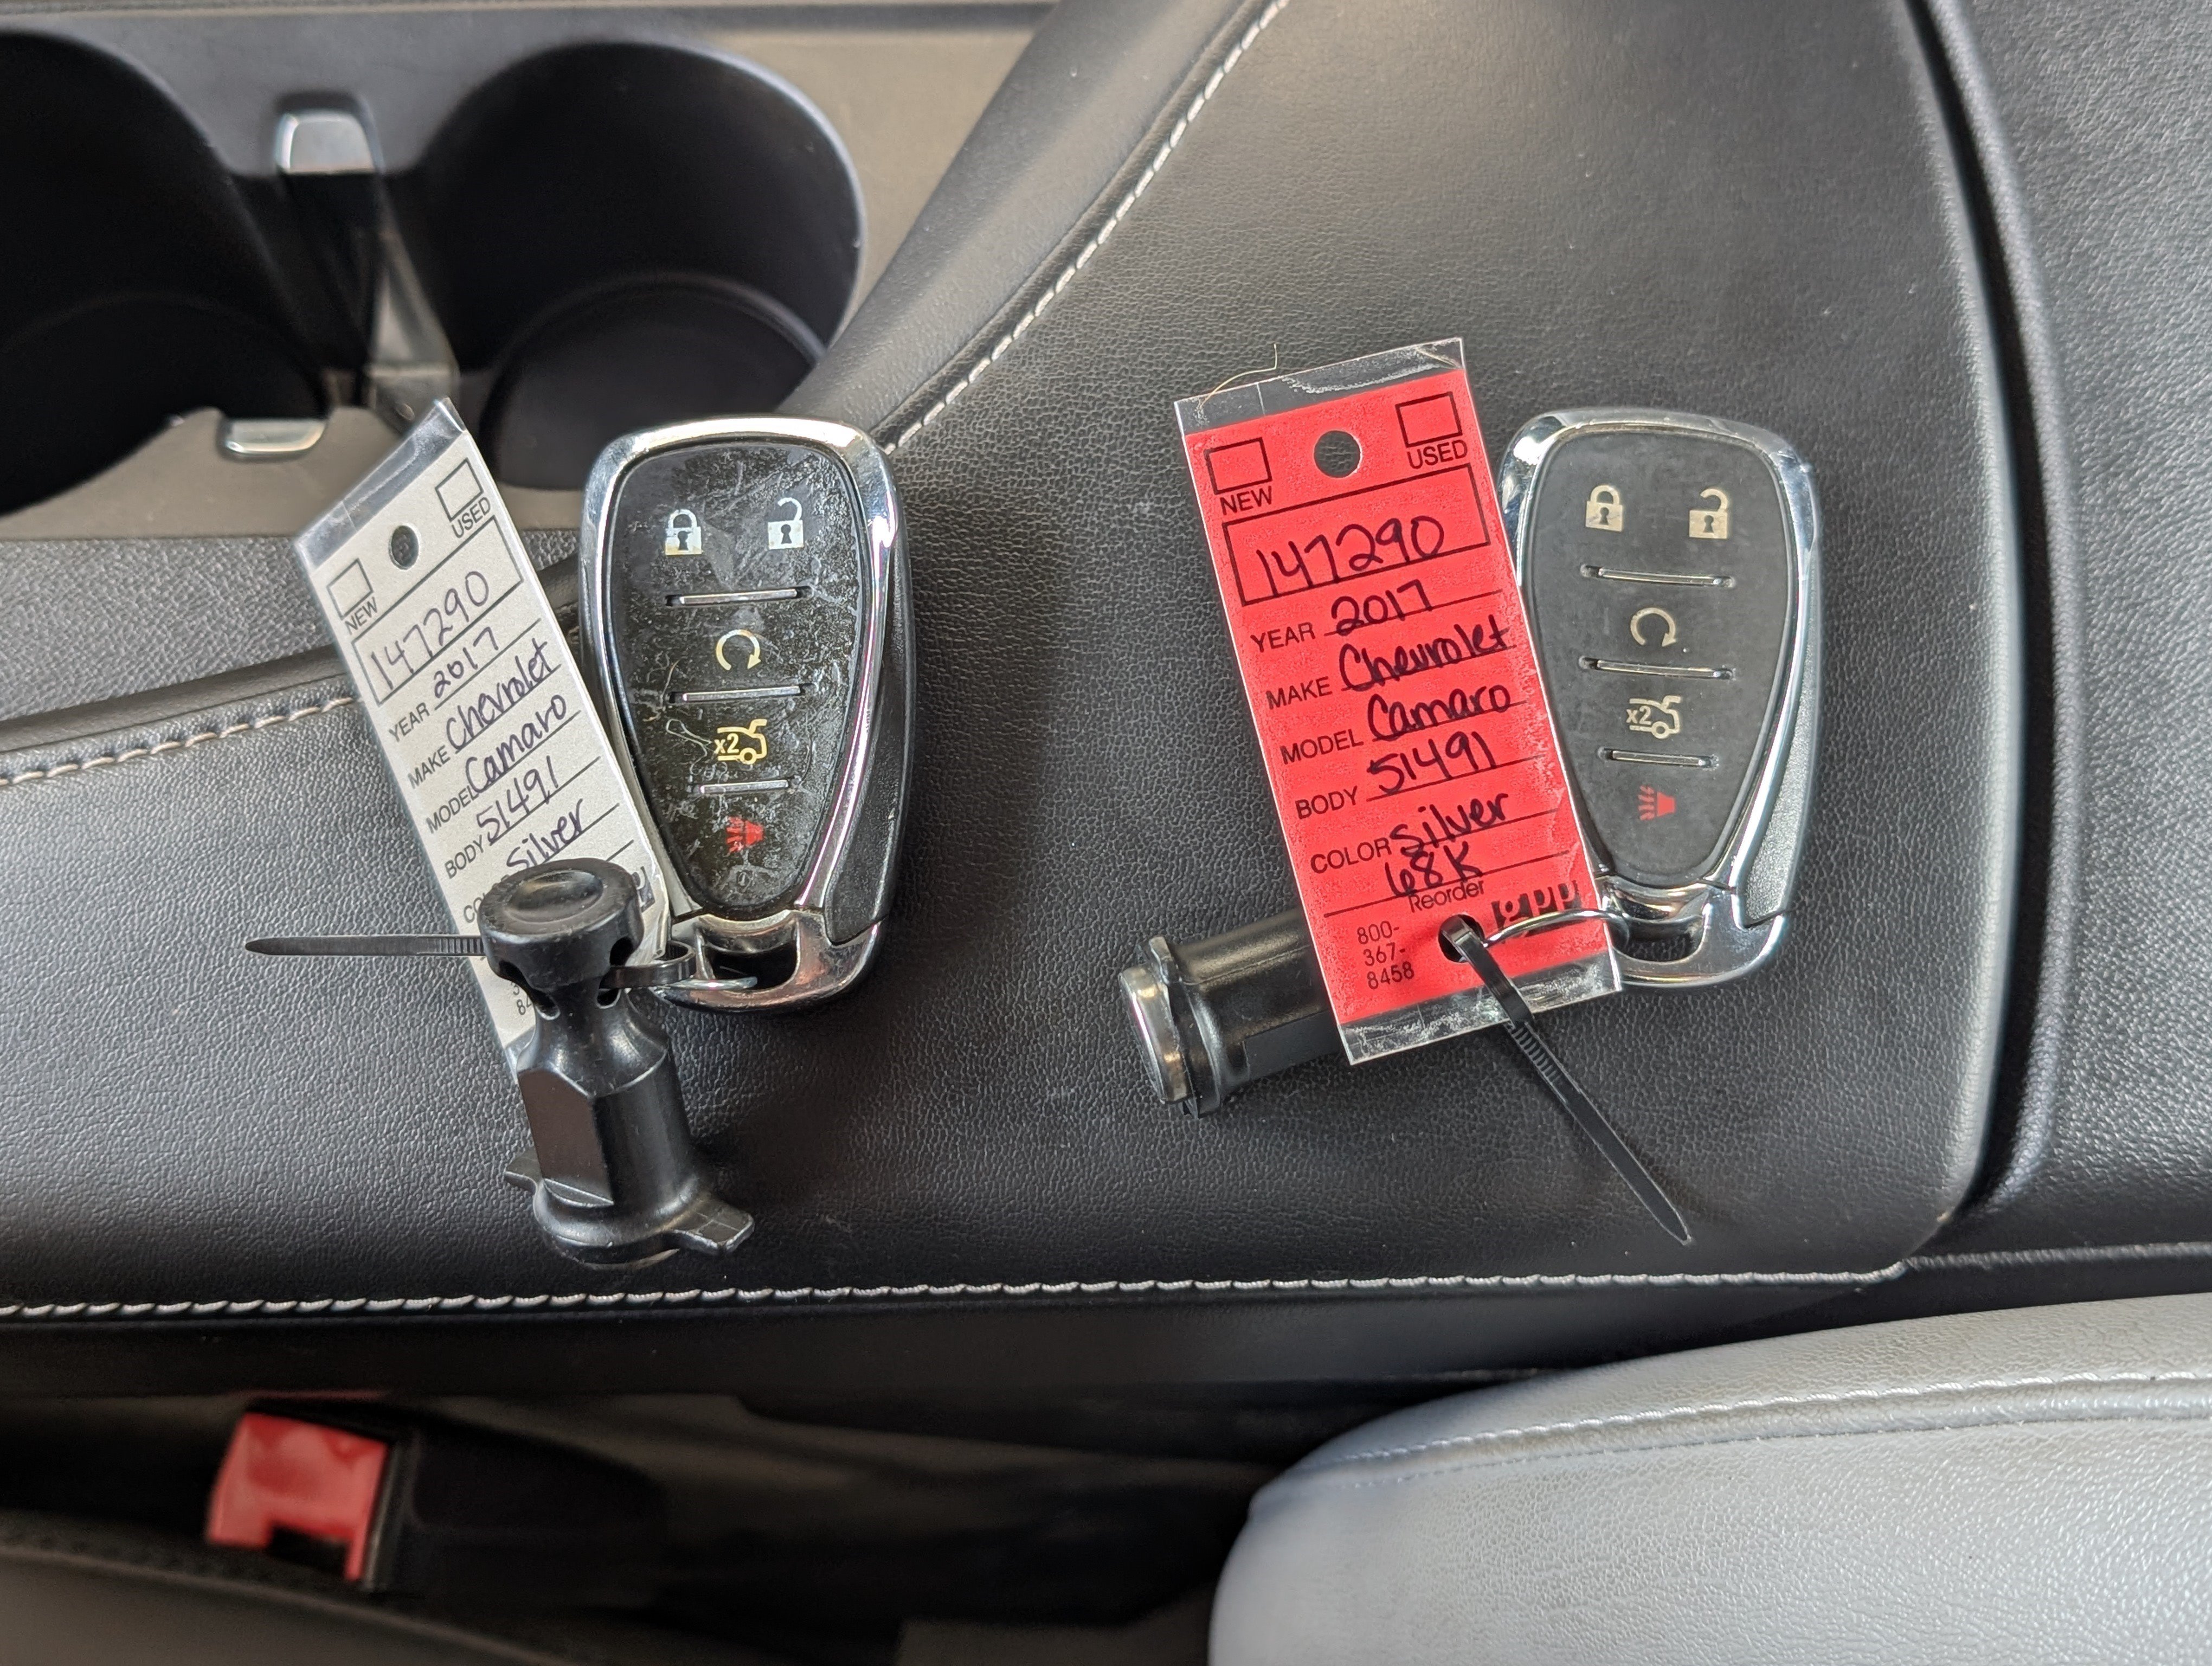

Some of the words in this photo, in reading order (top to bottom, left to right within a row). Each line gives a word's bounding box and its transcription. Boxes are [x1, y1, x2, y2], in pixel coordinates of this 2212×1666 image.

[1407, 439, 1468, 470] USED
[451, 497, 491, 539] USED
[1219, 486, 1272, 515] NEW
[1256, 515, 1444, 598] 147290
[344, 597, 379, 635] NEW
[370, 571, 490, 690] 147290
[1250, 621, 1316, 652] YEAR
[1331, 579, 1433, 636] 2017
[388, 702, 430, 742] YEAR
[434, 626, 498, 699] 2017
[1266, 676, 1333, 709] MAKE
[1339, 614, 1510, 692] Chevrolet
[408, 745, 451, 789] MAKE
[446, 638, 552, 751] Chevrolet
[1280, 729, 1364, 765] MODEL
[1368, 684, 1510, 741] Camaro
[426, 785, 480, 834] MODEL
[465, 694, 567, 793] Camaro
[1295, 786, 1358, 819] BODY
[1367, 731, 1497, 795] 51491
[445, 834, 485, 879] BODY
[477, 755, 559, 845] 51491
[506, 798, 584, 869] Silver
[1310, 838, 1392, 874] COLOR
[1390, 793, 1509, 857] Silver
[1385, 841, 1483, 896] 68K
[1410, 879, 1486, 913] Reorder
[1357, 922, 1401, 945] 800-
[1363, 944, 1406, 967] 367-
[1367, 964, 1415, 990] 8458
